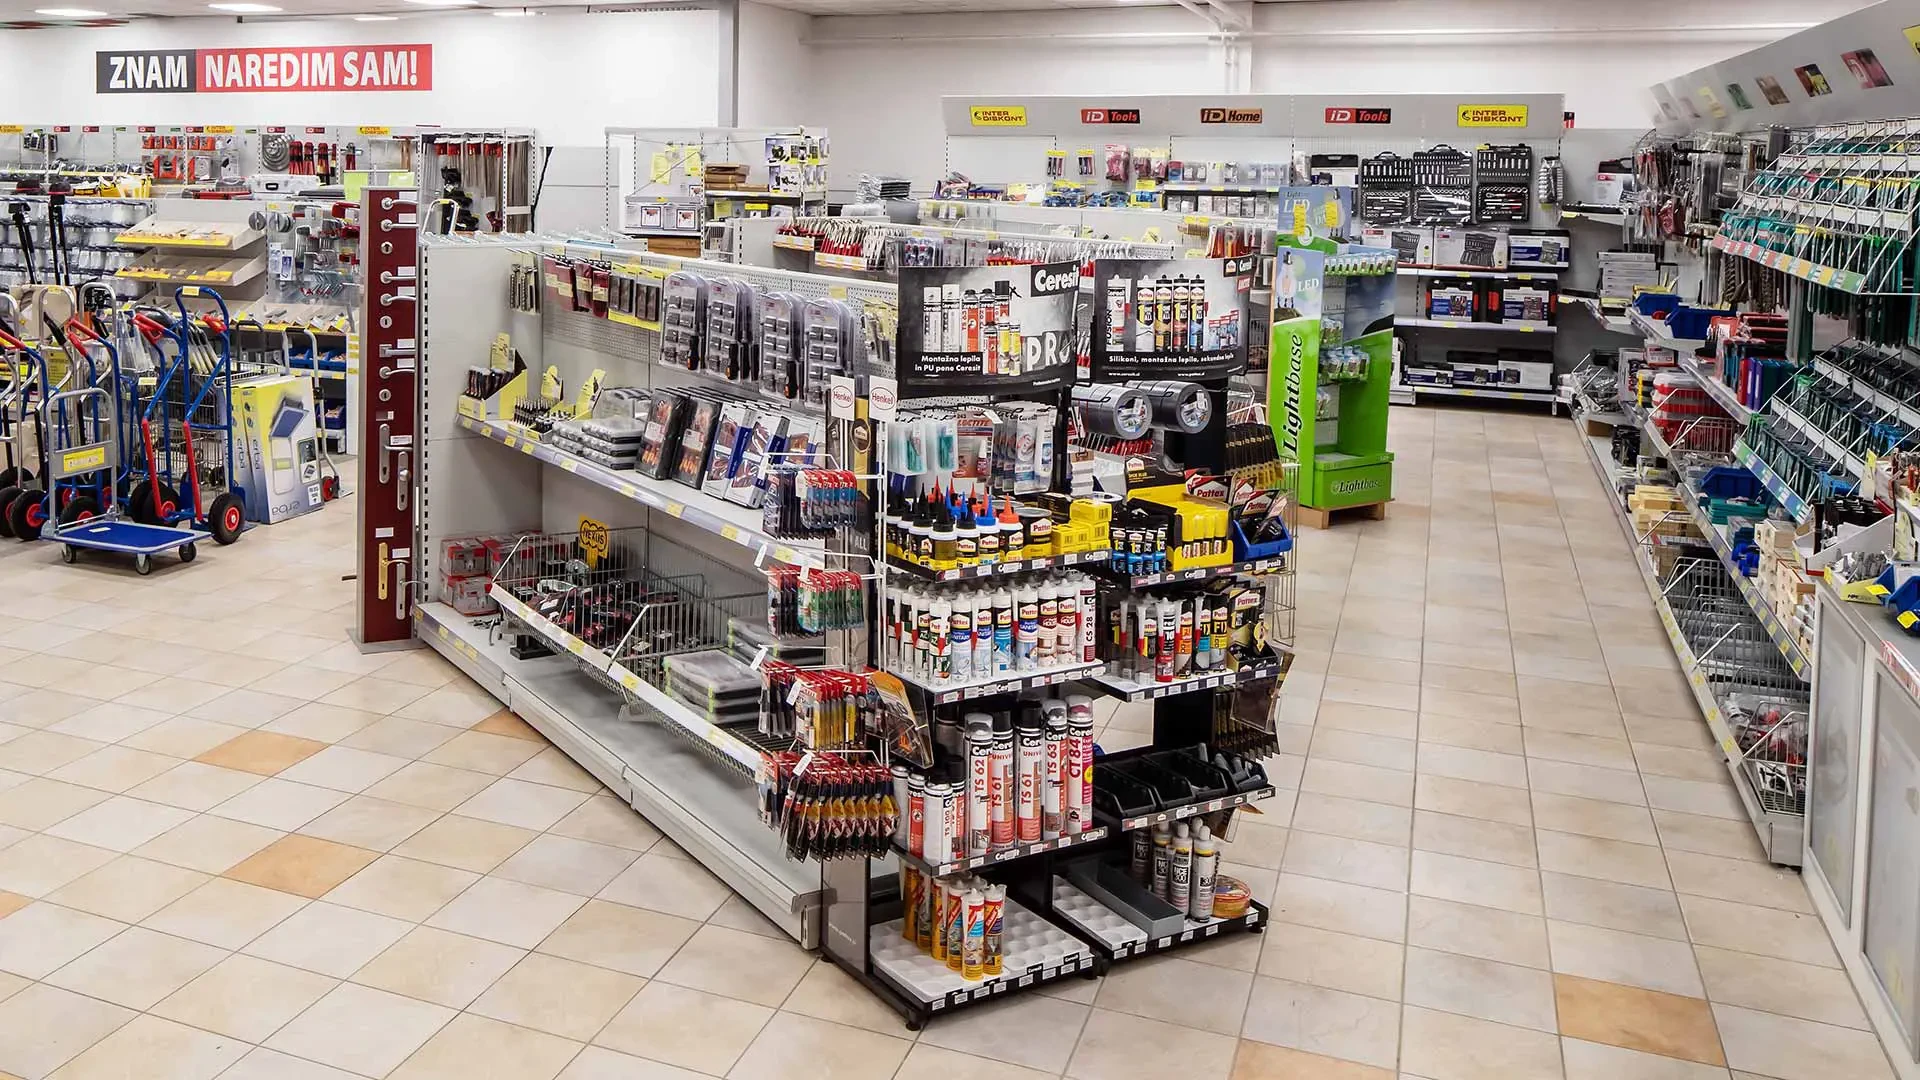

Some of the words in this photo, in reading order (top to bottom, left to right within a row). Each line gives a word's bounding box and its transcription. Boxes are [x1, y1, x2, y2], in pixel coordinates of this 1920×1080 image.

[109, 55, 188, 90] ZNAM
[205, 51, 336, 89] NAREDIM
[343, 50, 418, 87] SAM!
[1111, 111, 1138, 122] Tools
[1228, 110, 1261, 123] Home
[1359, 110, 1389, 122] Tools
[1298, 278, 1319, 293] LED
[921, 354, 959, 363] Montažna
[914, 364, 923, 372] in
[924, 363, 935, 372] PU
[871, 391, 893, 405] Henkel
[1282, 334, 1303, 455] Lightbase
[1196, 489, 1225, 498] Pattex
[583, 527, 605, 544] NEXUS
[957, 542, 975, 550] Pattex
[1085, 616, 1093, 628] 28
[1085, 630, 1093, 642] CS
[1047, 743, 1057, 760] 63
[1069, 738, 1081, 759] 84
[974, 759, 985, 776] 62
[1047, 761, 1057, 775] TS
[1069, 759, 1081, 778] CT
[974, 778, 985, 793] TS
[991, 792, 1002, 808] TS
[1021, 788, 1032, 804] TS
